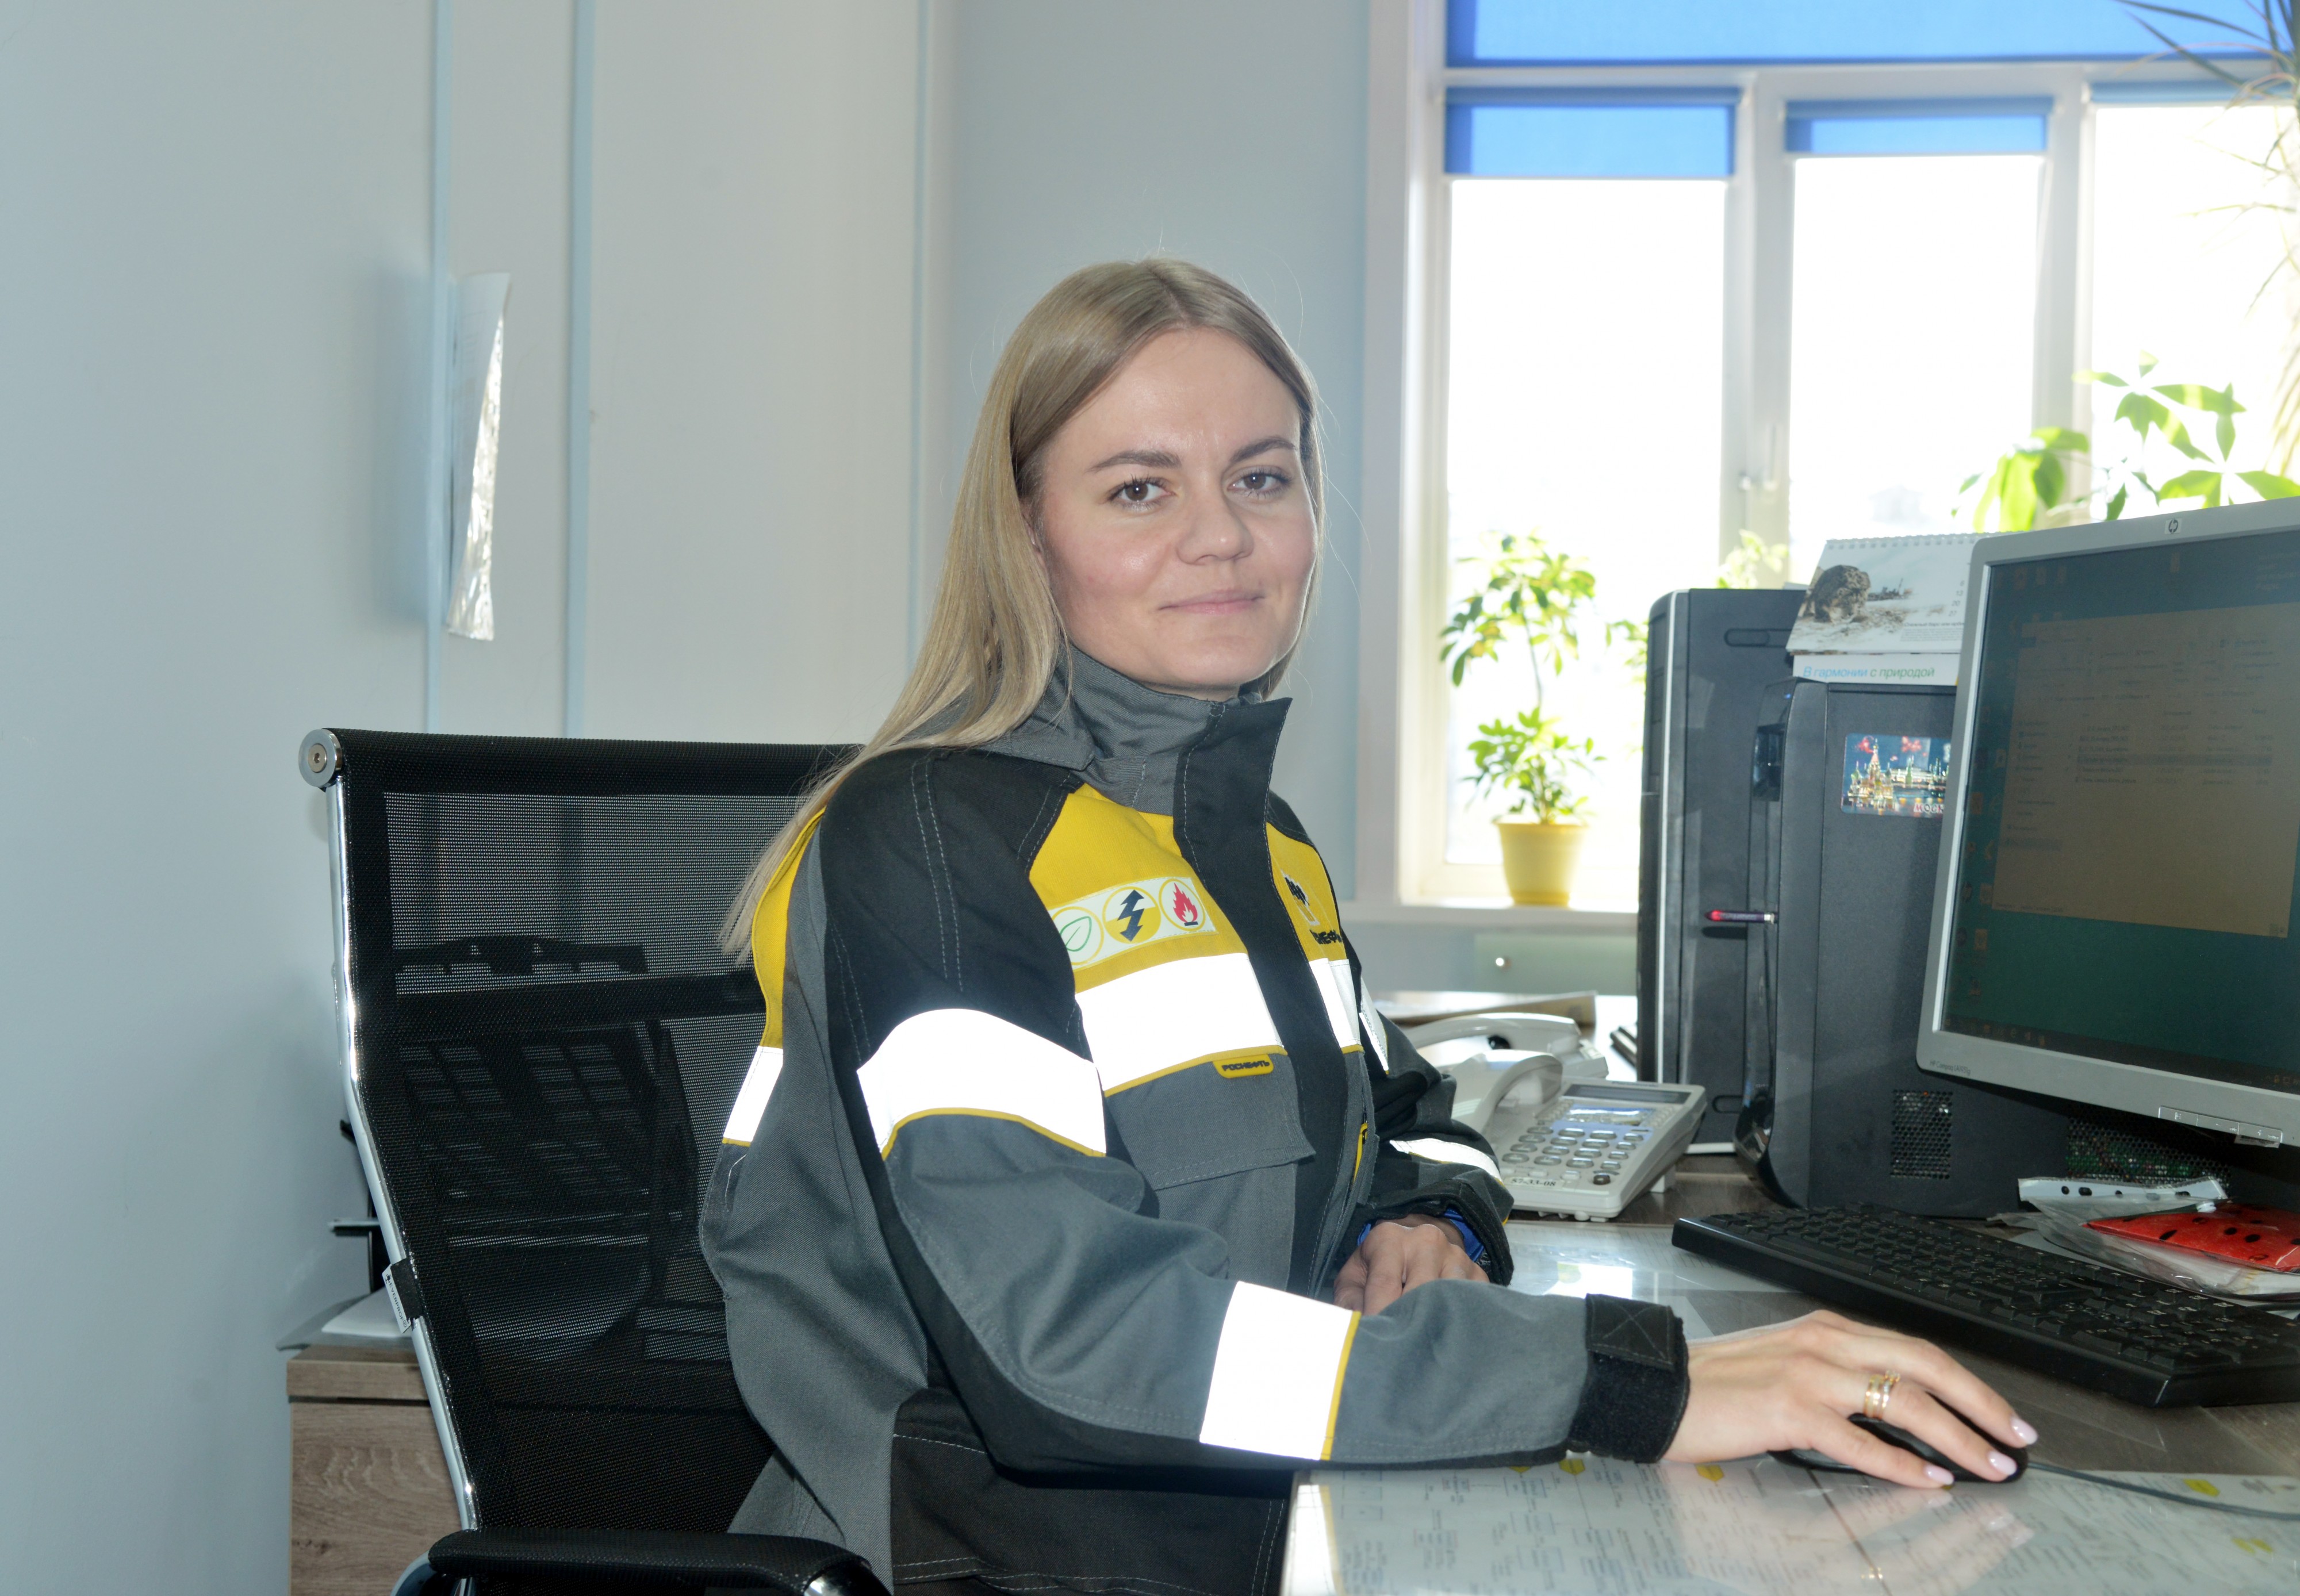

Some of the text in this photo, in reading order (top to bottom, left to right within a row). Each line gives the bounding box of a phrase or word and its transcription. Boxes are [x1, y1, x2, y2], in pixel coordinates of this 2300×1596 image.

[1803, 666, 1934, 679] В гармонии с природой
